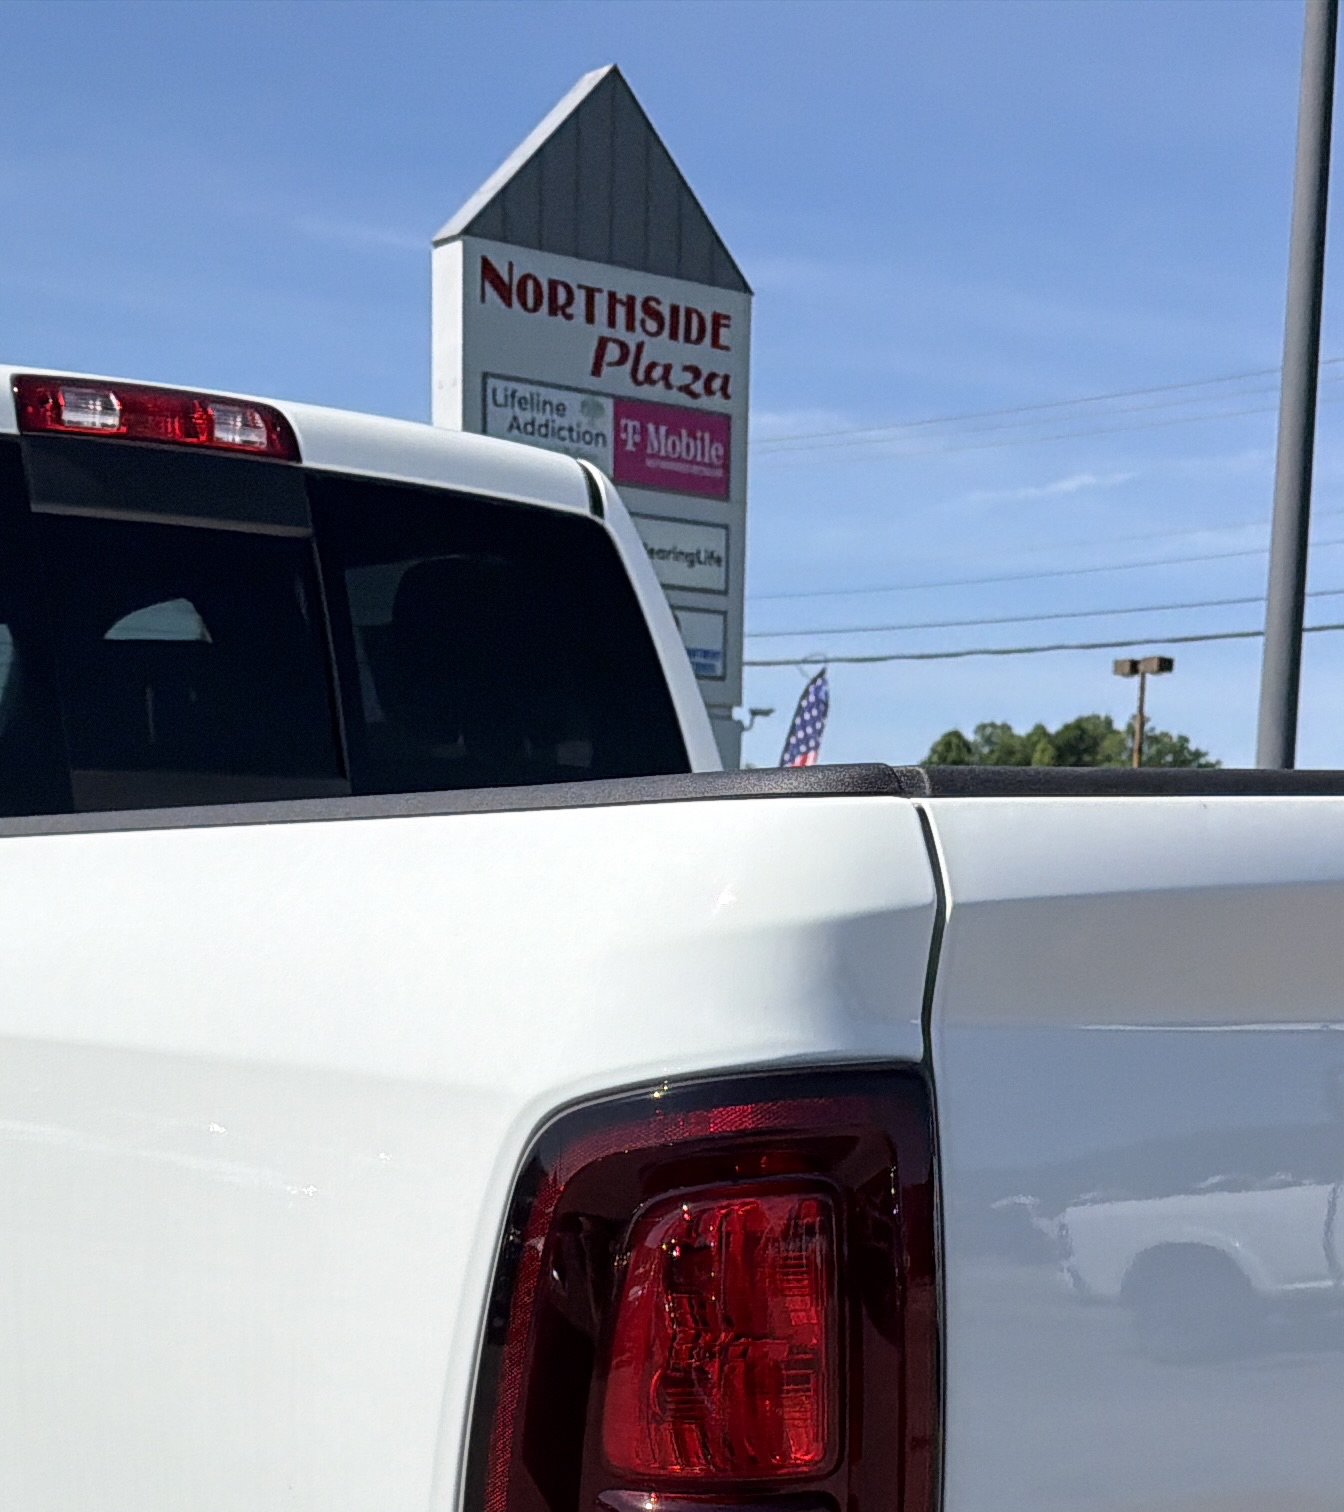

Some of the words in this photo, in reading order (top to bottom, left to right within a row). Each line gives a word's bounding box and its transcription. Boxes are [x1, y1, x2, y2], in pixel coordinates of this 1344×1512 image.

[480, 255, 732, 352] NORTHSIDE
[590, 335, 732, 400] Plaza
[491, 386, 567, 418] Lifeline
[507, 414, 608, 448] Addiction
[643, 541, 723, 569] earingLife
